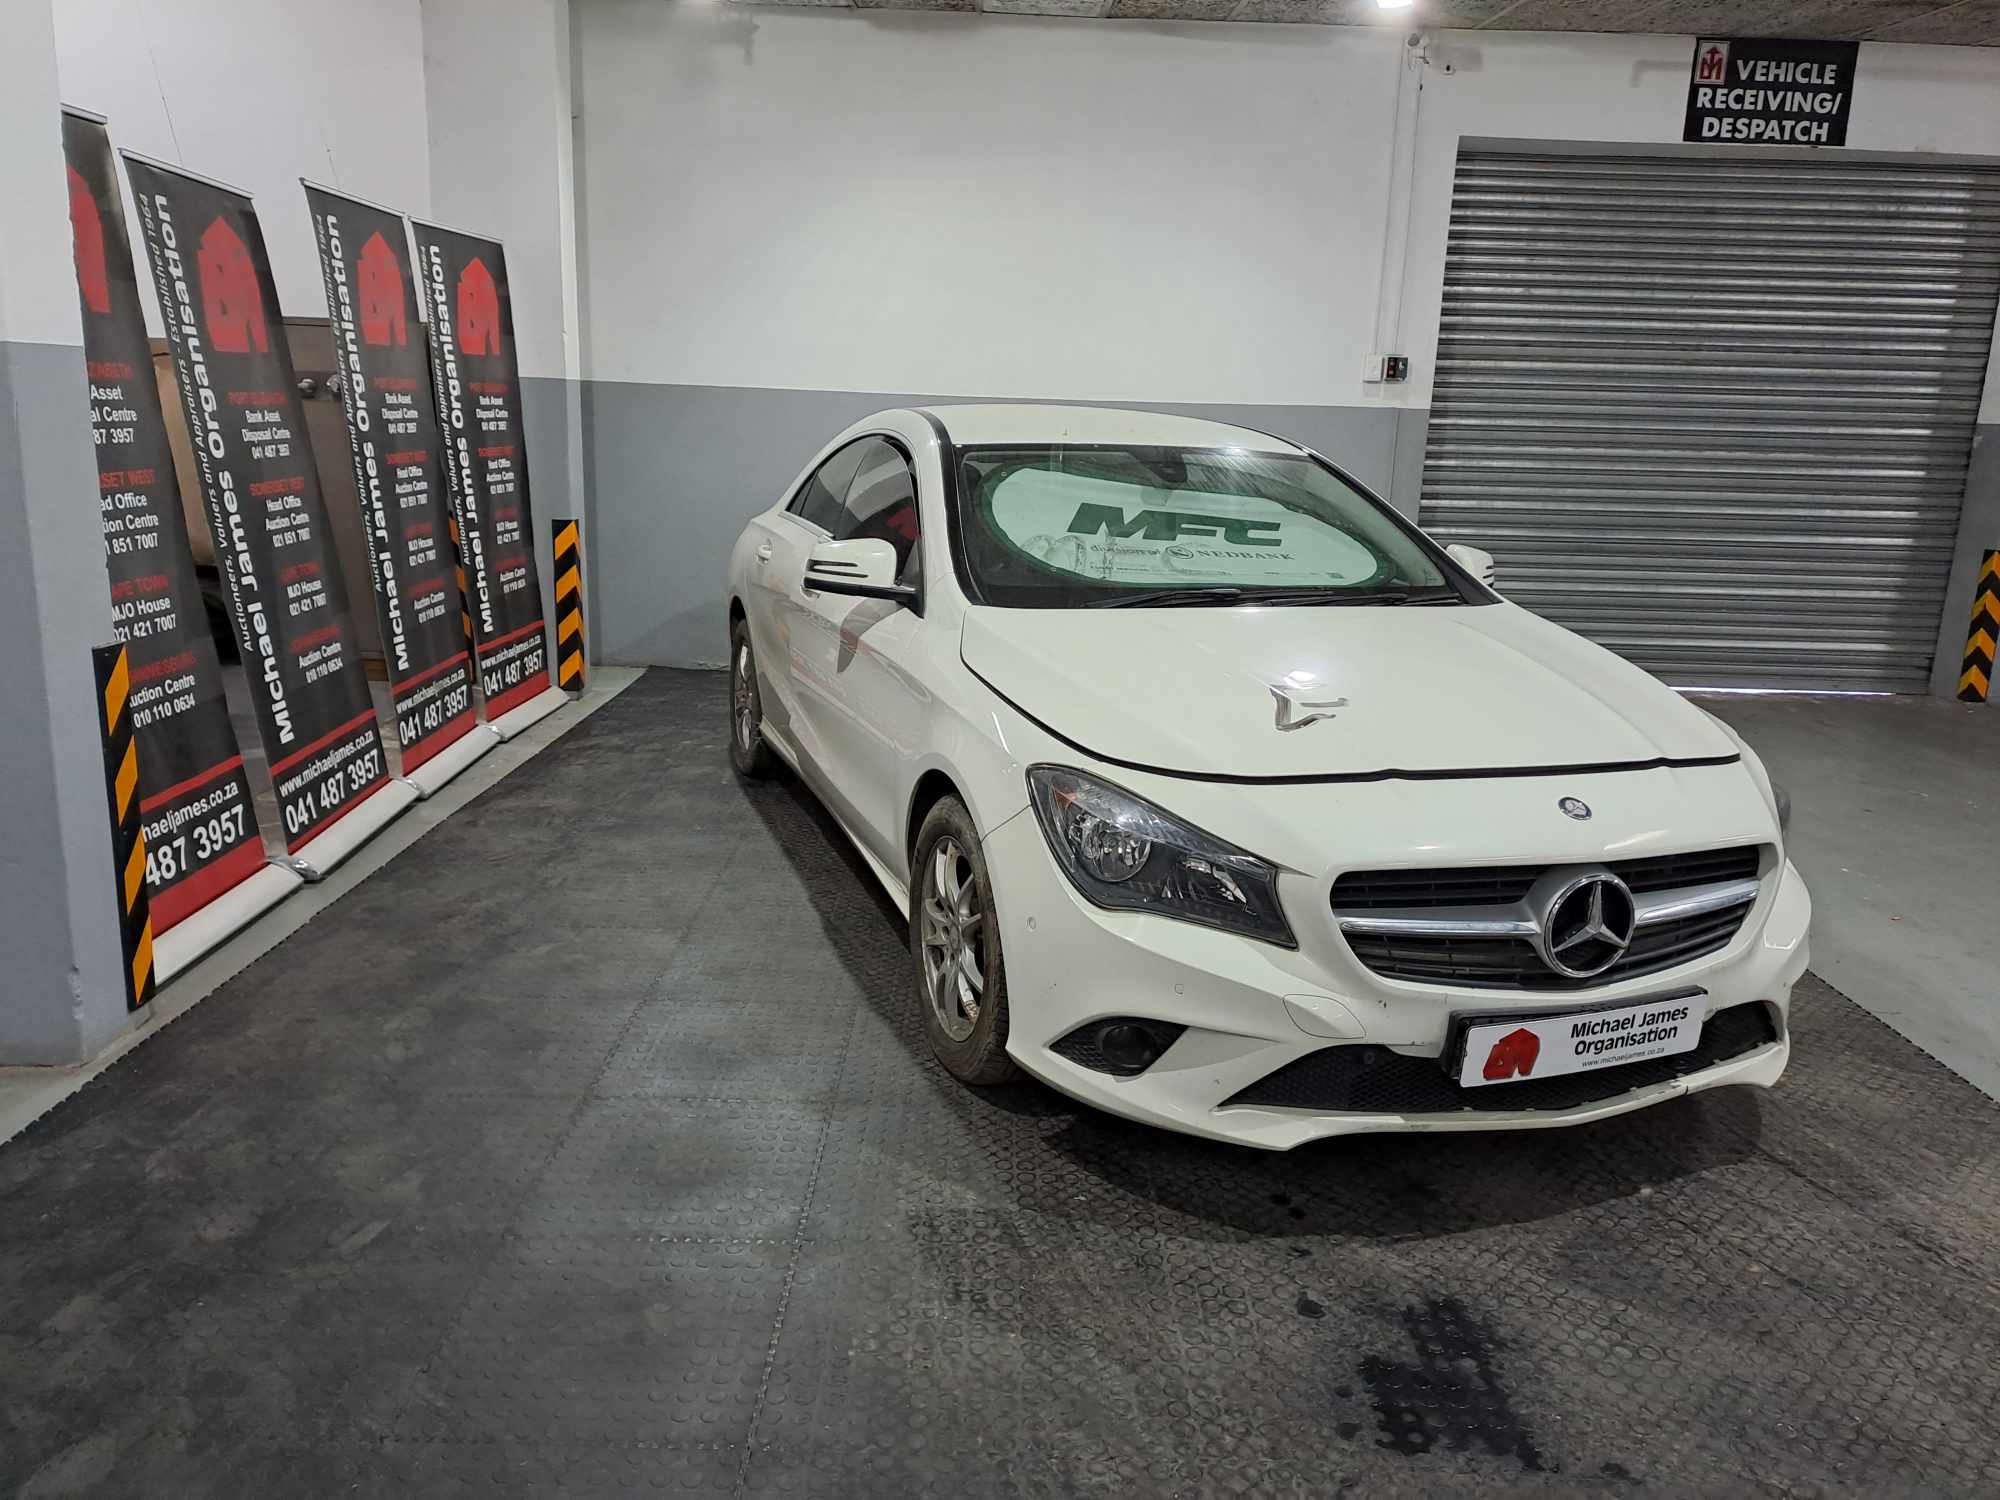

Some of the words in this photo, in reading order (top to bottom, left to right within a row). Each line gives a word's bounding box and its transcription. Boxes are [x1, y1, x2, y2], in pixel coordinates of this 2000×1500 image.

[1737, 59, 1837, 85] VEHICLE
[1696, 87, 1842, 115] RECEIVING/
[1702, 116, 1829, 142] DESPATCH
[150, 241, 181, 343] Established
[155, 194, 225, 459] Organisation
[326, 214, 370, 432] Organisation
[429, 245, 464, 429] Organisation
[90, 384, 123, 400] Asset
[102, 407, 138, 422] Centre
[178, 358, 205, 448] Appraisers
[111, 428, 135, 444] 3957
[198, 451, 213, 484] and
[354, 455, 367, 505] Valuers
[446, 449, 458, 491] Valuers
[456, 437, 478, 523] James
[114, 492, 148, 509] Office
[362, 441, 388, 543] James
[125, 513, 159, 530] Centre
[208, 488, 229, 548] Valuers
[218, 470, 258, 591] James
[1066, 502, 1282, 547] MFC
[112, 536, 133, 554] 851
[135, 532, 159, 550] 7007
[1197, 549, 1298, 561] NEDBANK
[225, 554, 253, 651] Auctioneers,
[469, 531, 494, 633] Michael
[133, 620, 153, 638] 421
[154, 613, 176, 633] 7007
[136, 597, 171, 615] House
[379, 551, 409, 671] Michael
[164, 673, 196, 694] Centre
[246, 602, 295, 745] Michael
[483, 669, 503, 696] 041
[505, 660, 521, 684] 487
[523, 649, 543, 676] 3957
[133, 709, 151, 728] 010
[153, 701, 172, 720] 110
[173, 692, 196, 713] 0634
[400, 712, 422, 746] 041
[424, 700, 442, 730] 487
[443, 684, 467, 717] 3957
[279, 730, 374, 798] www.michaeljames.co.za
[285, 791, 317, 834] 041
[320, 771, 345, 809] 487
[347, 748, 380, 790] 3957
[193, 803, 244, 859] 3957
[1571, 1014, 1636, 1038] Michael
[1638, 1007, 1688, 1028] James
[1574, 1025, 1678, 1055] Organisation
